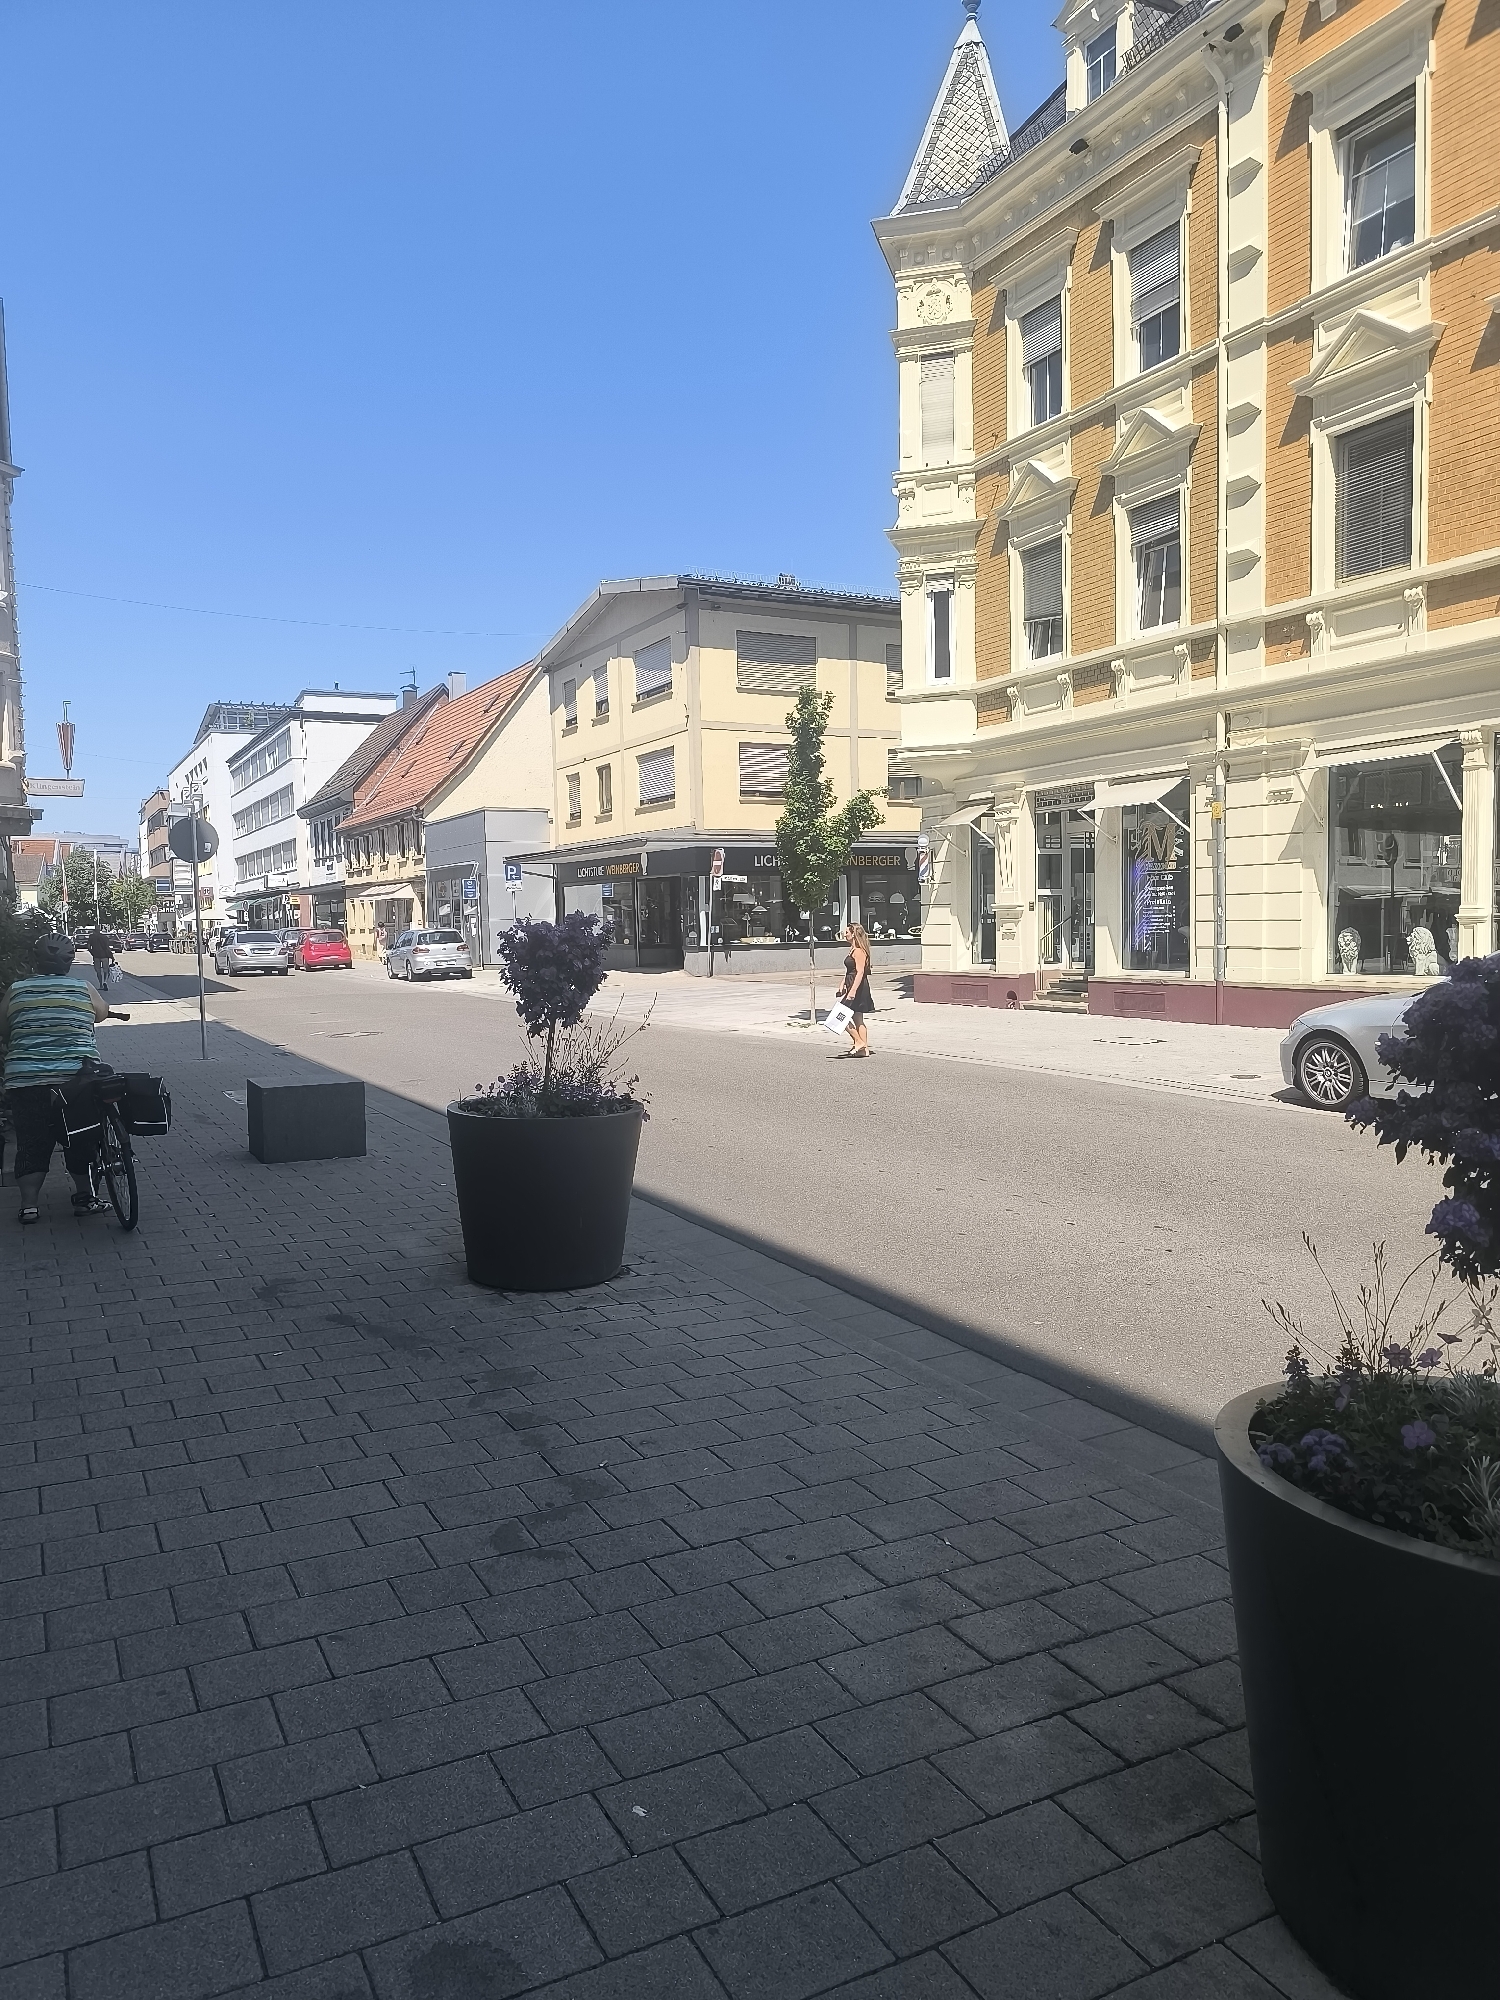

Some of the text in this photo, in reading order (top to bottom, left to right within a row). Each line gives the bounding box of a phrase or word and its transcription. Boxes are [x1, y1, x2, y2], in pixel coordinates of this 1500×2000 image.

[29, 782, 81, 793] Klingenstein
[847, 855, 901, 866] NBERGER
[507, 865, 517, 880] P
[577, 862, 640, 878] LICHTSTUBE WEINBERGER
